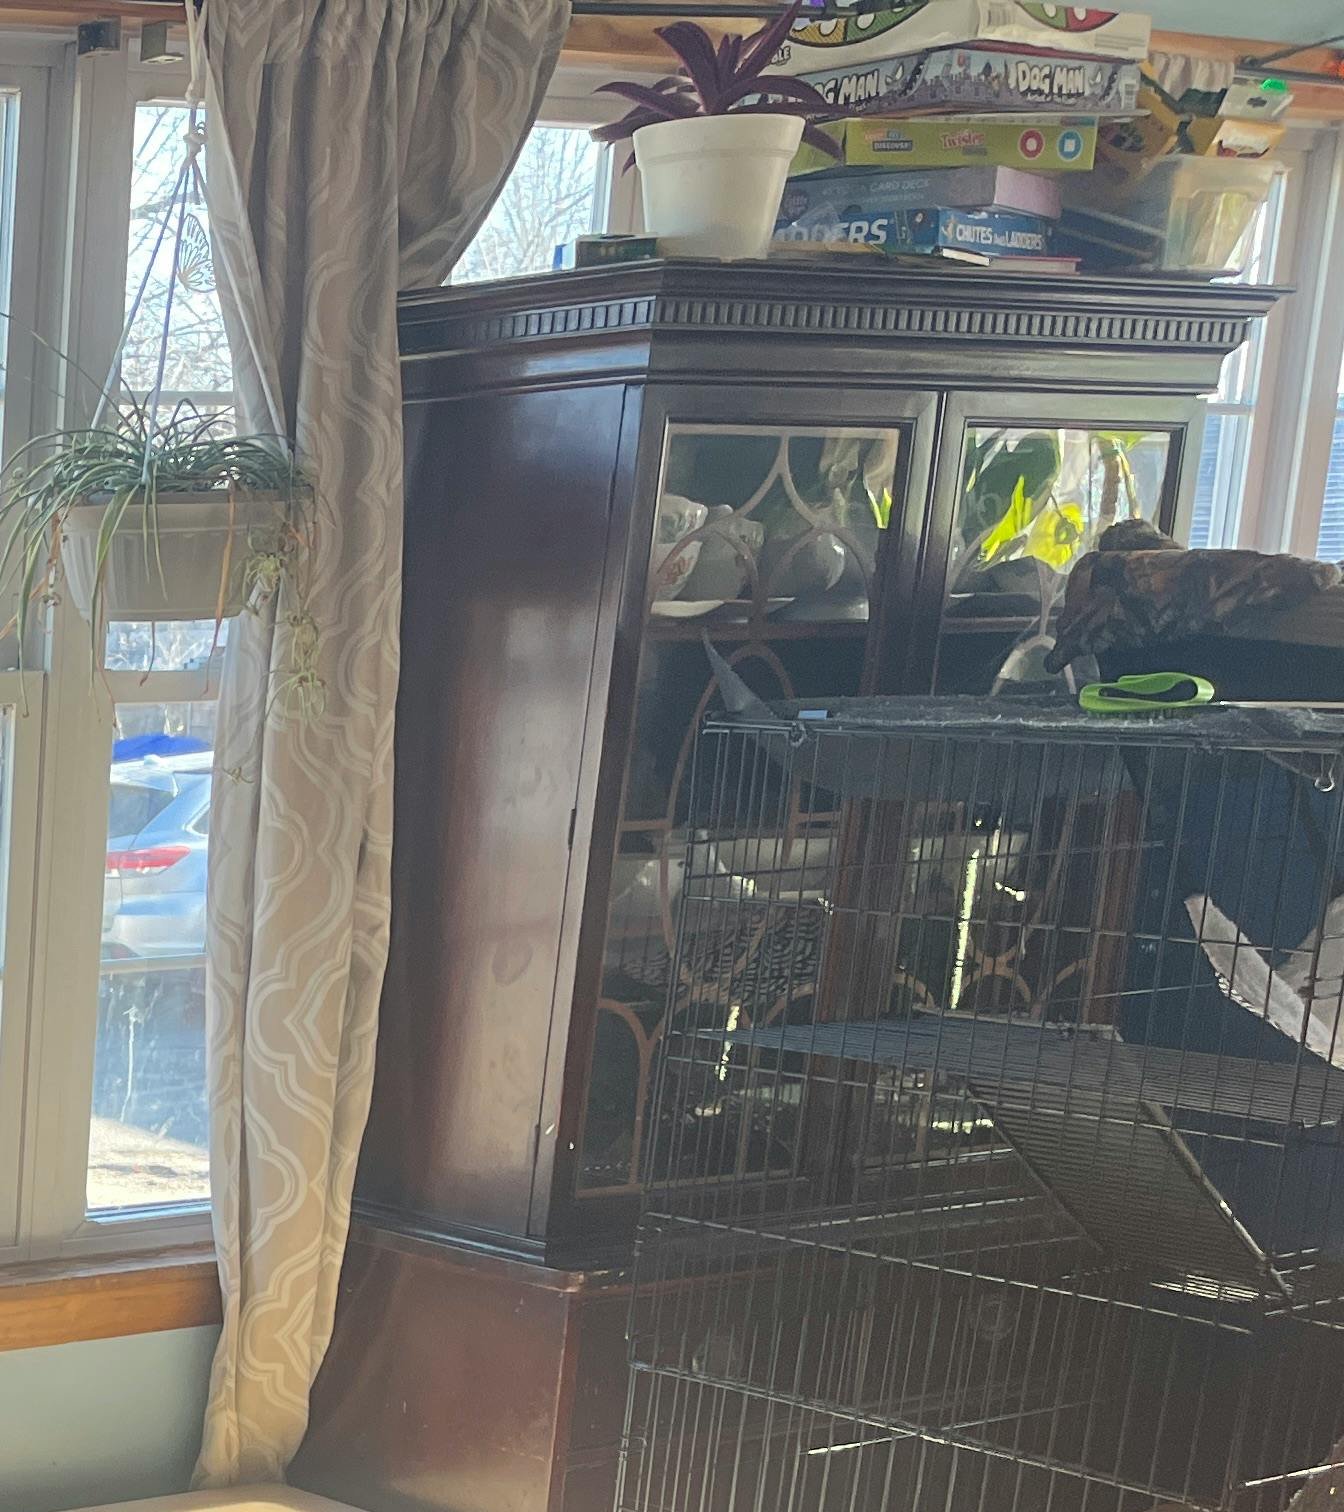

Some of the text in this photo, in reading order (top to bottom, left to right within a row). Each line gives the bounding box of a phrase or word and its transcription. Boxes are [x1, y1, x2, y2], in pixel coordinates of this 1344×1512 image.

[837, 69, 880, 105] MAN
[1015, 60, 1086, 96] DOG MAN
[940, 131, 986, 148] Twister
[773, 219, 889, 245] ADDERS
[956, 223, 993, 244] CHUTES
